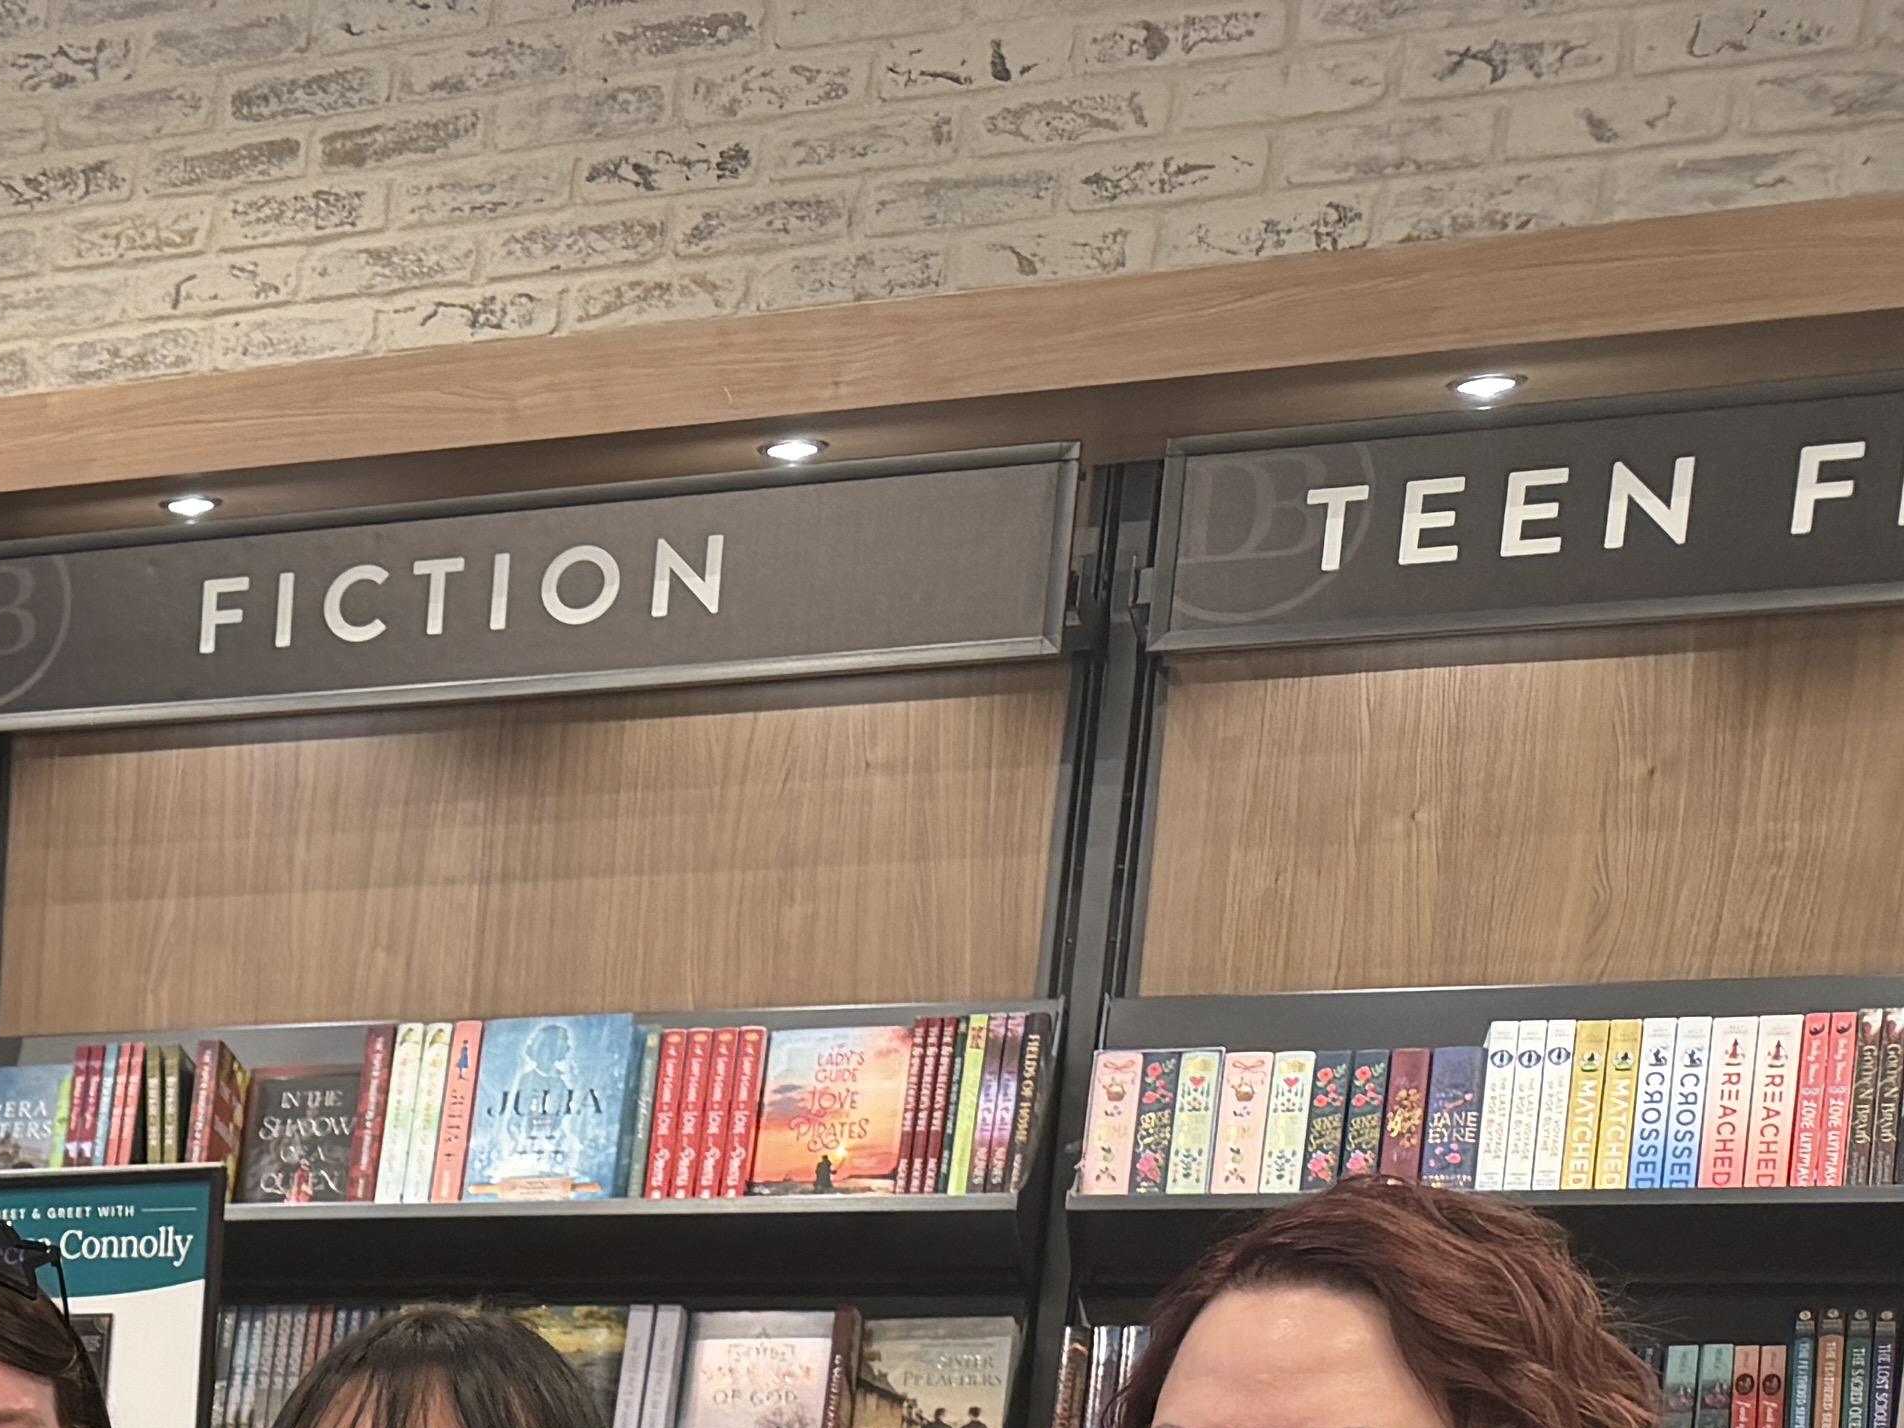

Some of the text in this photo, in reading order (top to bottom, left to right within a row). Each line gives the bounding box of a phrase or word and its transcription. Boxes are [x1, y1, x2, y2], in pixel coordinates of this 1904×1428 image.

[1306, 455, 1695, 572] TEEN
[197, 533, 726, 655] FICTION
[817, 1051, 865, 1066] LADY'S
[815, 1067, 859, 1083] GUIDE
[801, 1085, 859, 1117] LOVE
[1015, 1034, 1040, 1144] FIELDS OF HOME
[487, 1088, 602, 1118] JULIA
[259, 1116, 356, 1140] SHADOW
[1432, 1111, 1480, 1129] JANE
[1568, 1079, 1598, 1186] MATCHED
[1601, 1079, 1630, 1186] MATCHED
[789, 1117, 869, 1152] PIRATES
[1428, 1127, 1477, 1145] EYRE
[260, 1172, 342, 1194] QEN
[31, 1208, 41, 1219] &
[47, 1206, 92, 1219] GREET
[97, 1205, 135, 1218] WITH
[59, 1225, 193, 1268] Connolly
[937, 1353, 993, 1370] SISTER
[1851, 1348, 1866, 1367] THE
[1878, 1344, 1891, 1363] THE
[902, 1370, 1002, 1387] PREACHERS
[1849, 1369, 1865, 1405] SACRED
[1875, 1364, 1890, 1390] LOST
